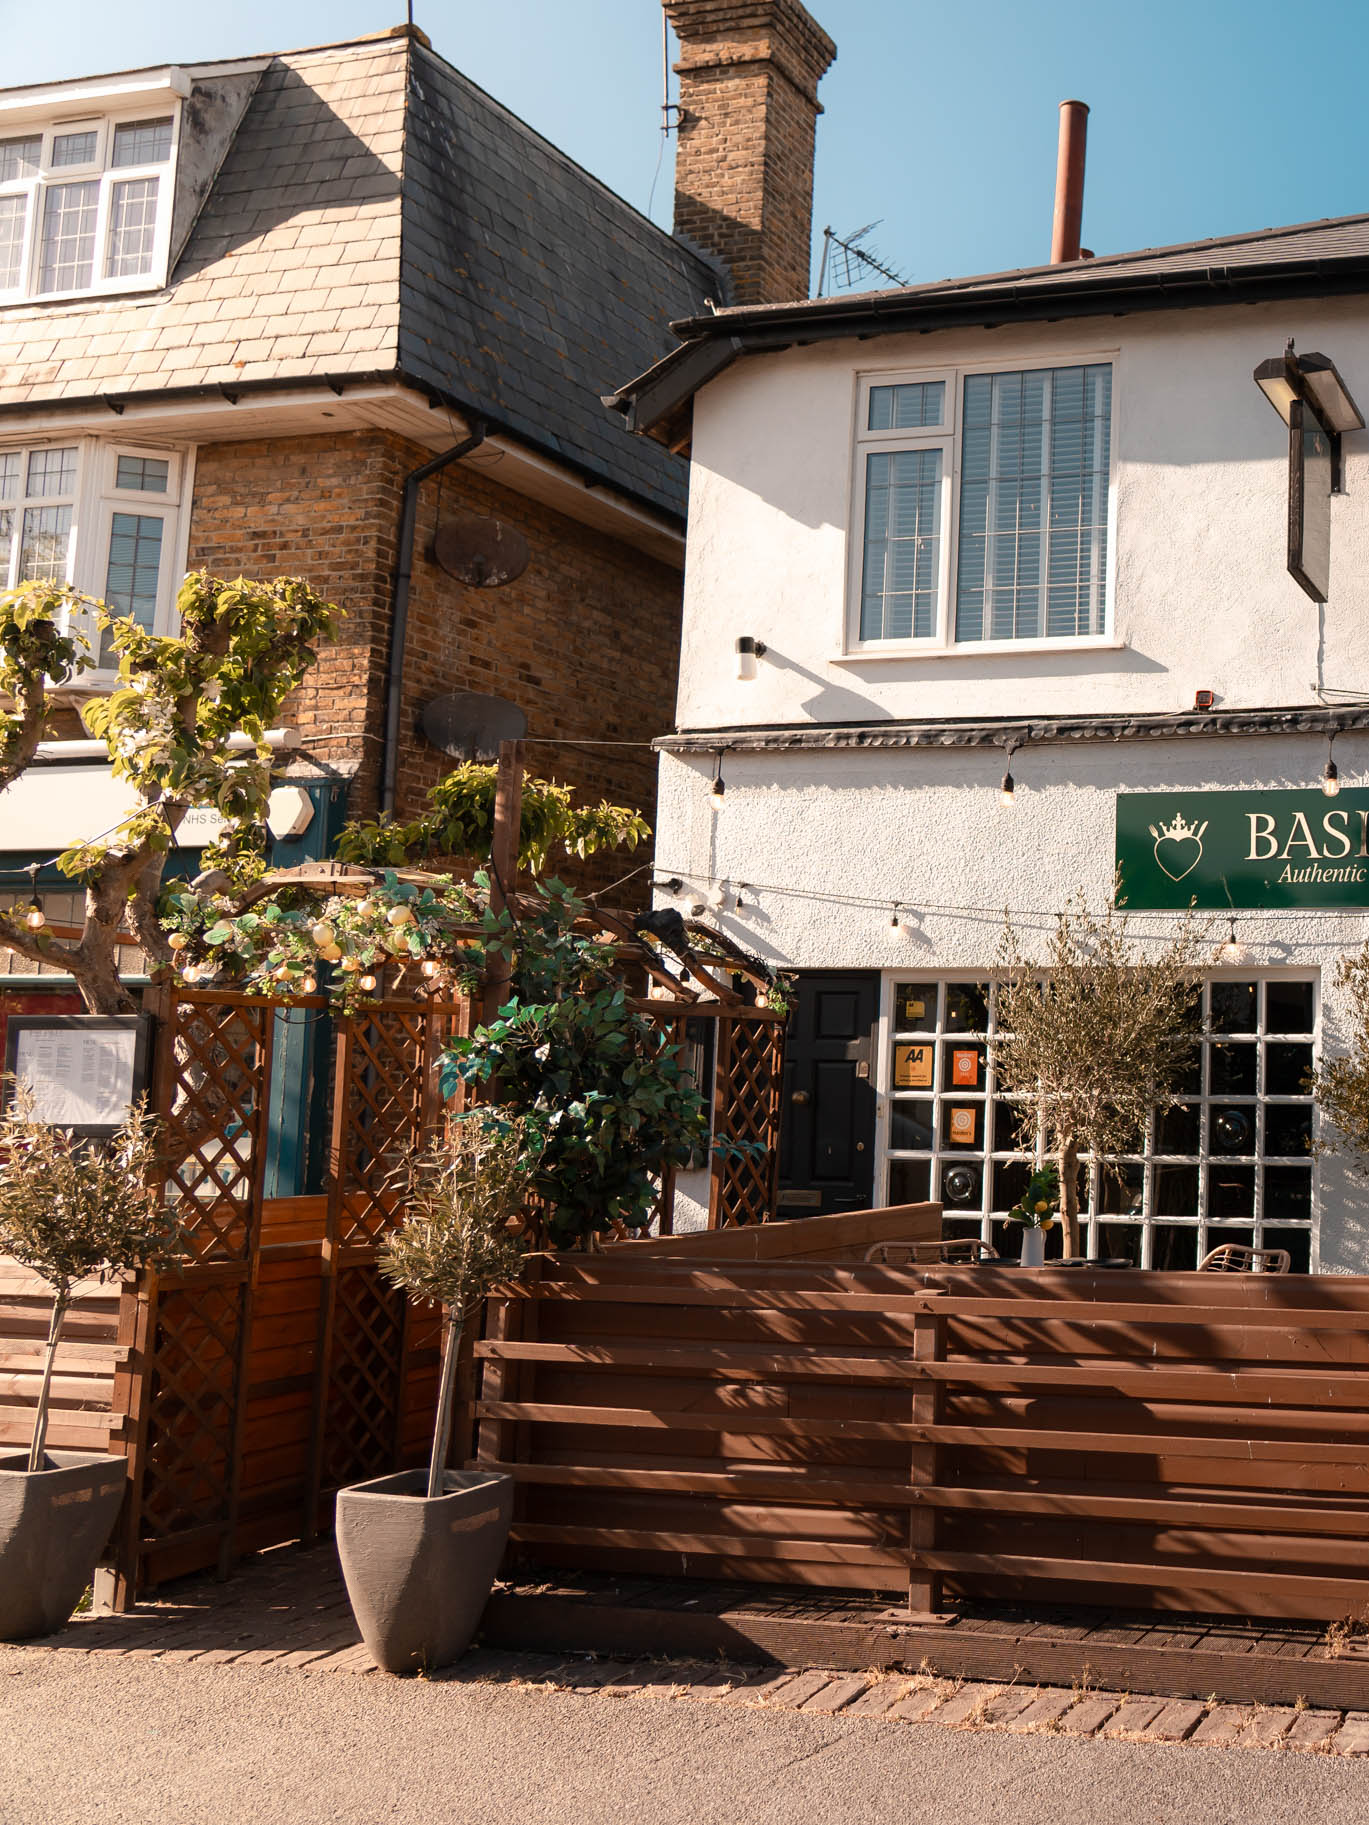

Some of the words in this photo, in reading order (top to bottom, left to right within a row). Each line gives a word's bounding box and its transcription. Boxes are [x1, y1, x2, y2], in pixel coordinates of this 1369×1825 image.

[183, 814, 207, 824] NHS
[1277, 862, 1368, 884] Authentic
[905, 1048, 924, 1063] AA
